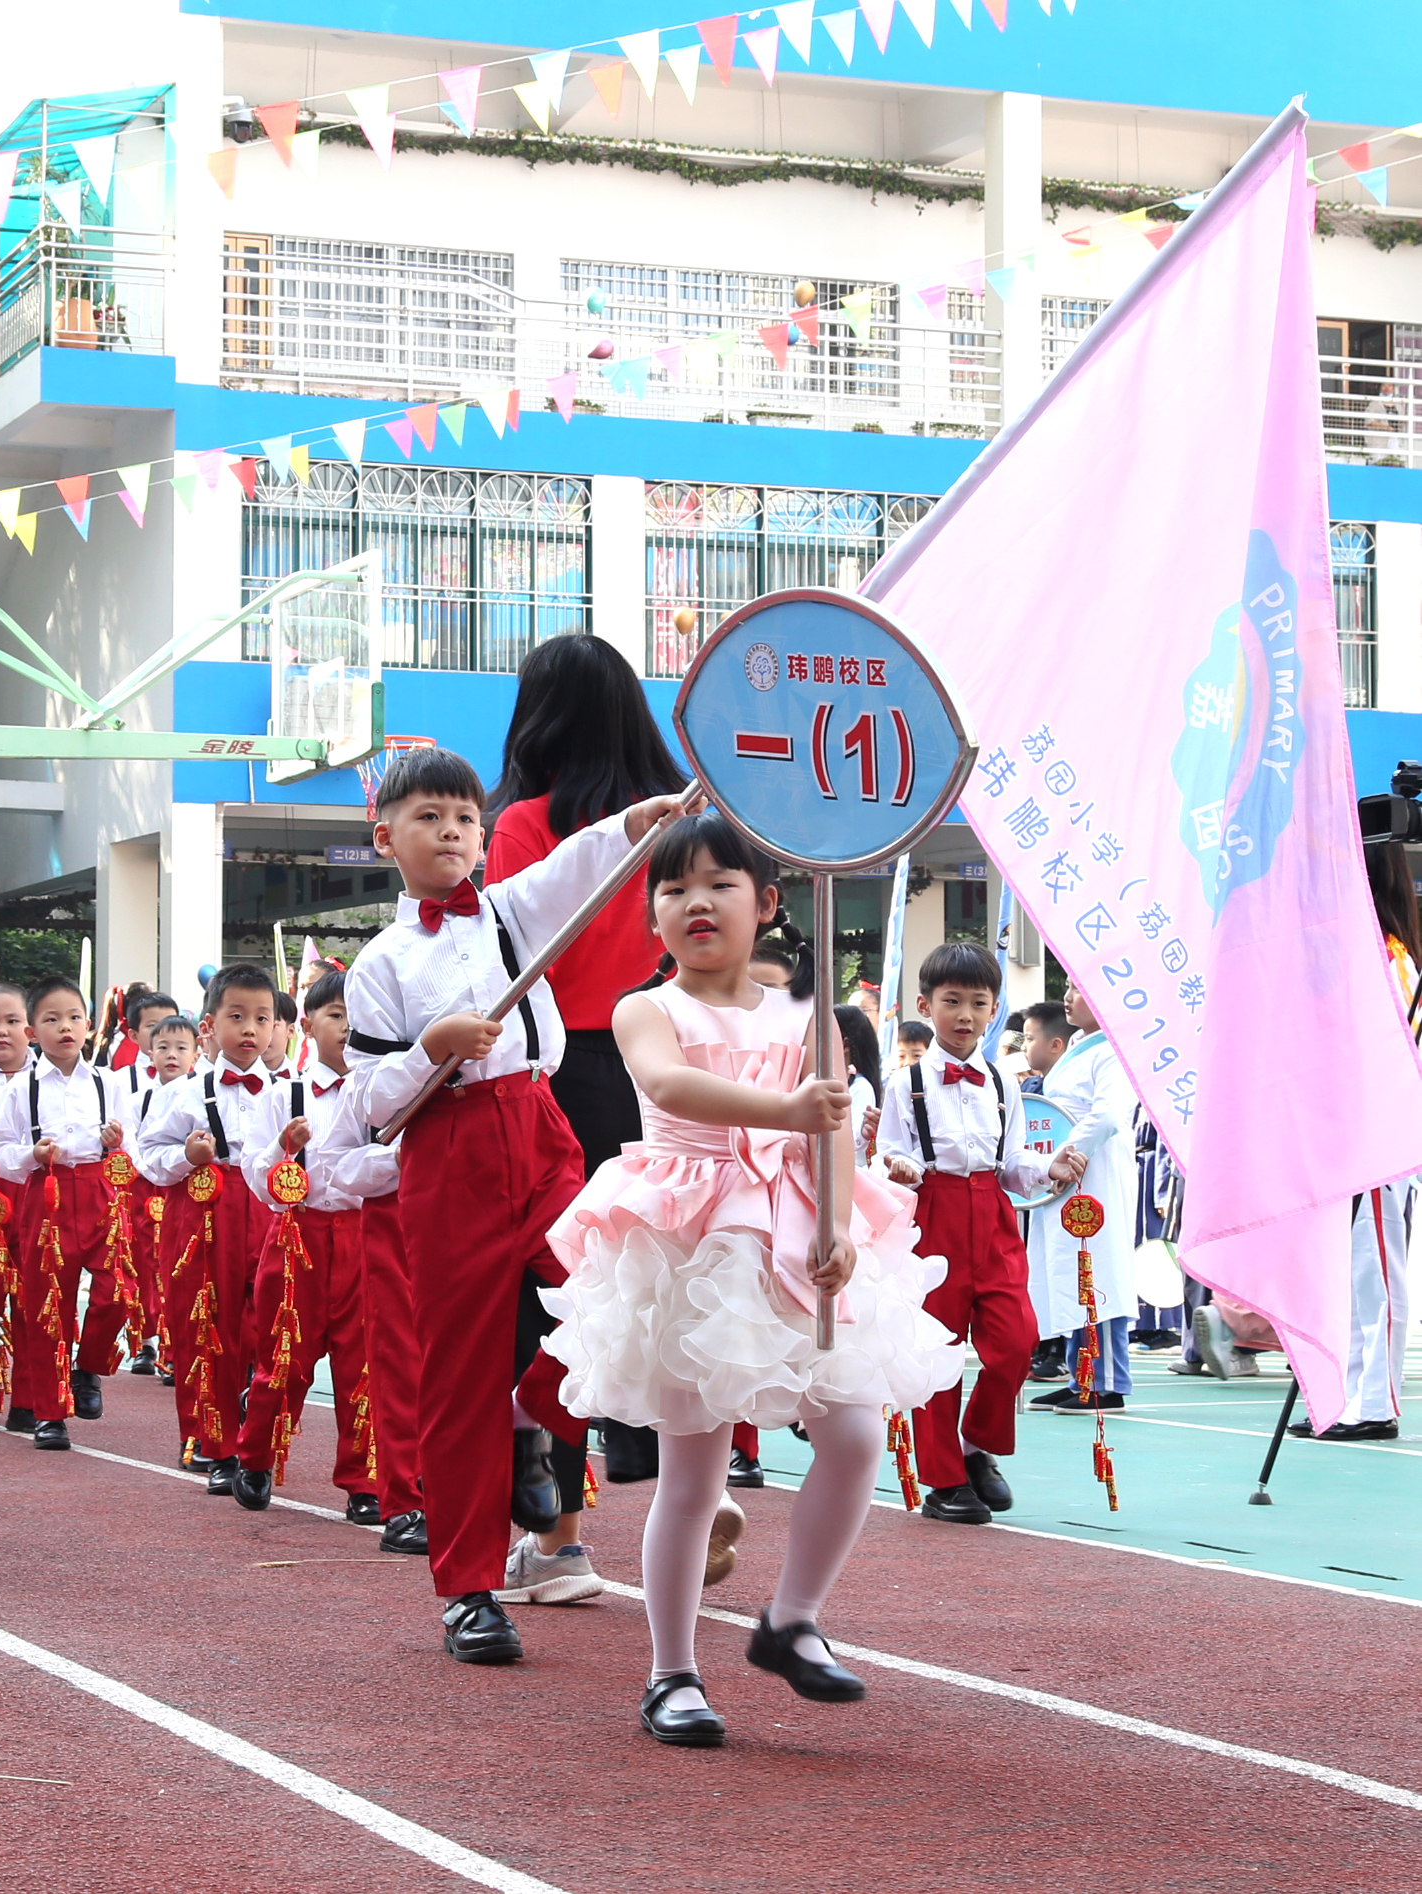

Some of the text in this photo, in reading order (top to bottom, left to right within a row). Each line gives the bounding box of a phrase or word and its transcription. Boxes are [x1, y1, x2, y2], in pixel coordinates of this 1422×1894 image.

[786, 653, 888, 687] 玮鹏校区
[1249, 582, 1295, 784] PRIMARY
[189, 739, 266, 755] 金陵
[734, 702, 915, 807] 一(1)
[334, 849, 370, 861] 二(2)班
[964, 866, 987, 877] 三(3)
[1021, 723, 1205, 1032] 荔园小学（荔园教
[281, 1165, 301, 1187] 福
[1071, 1199, 1094, 1222] 福
